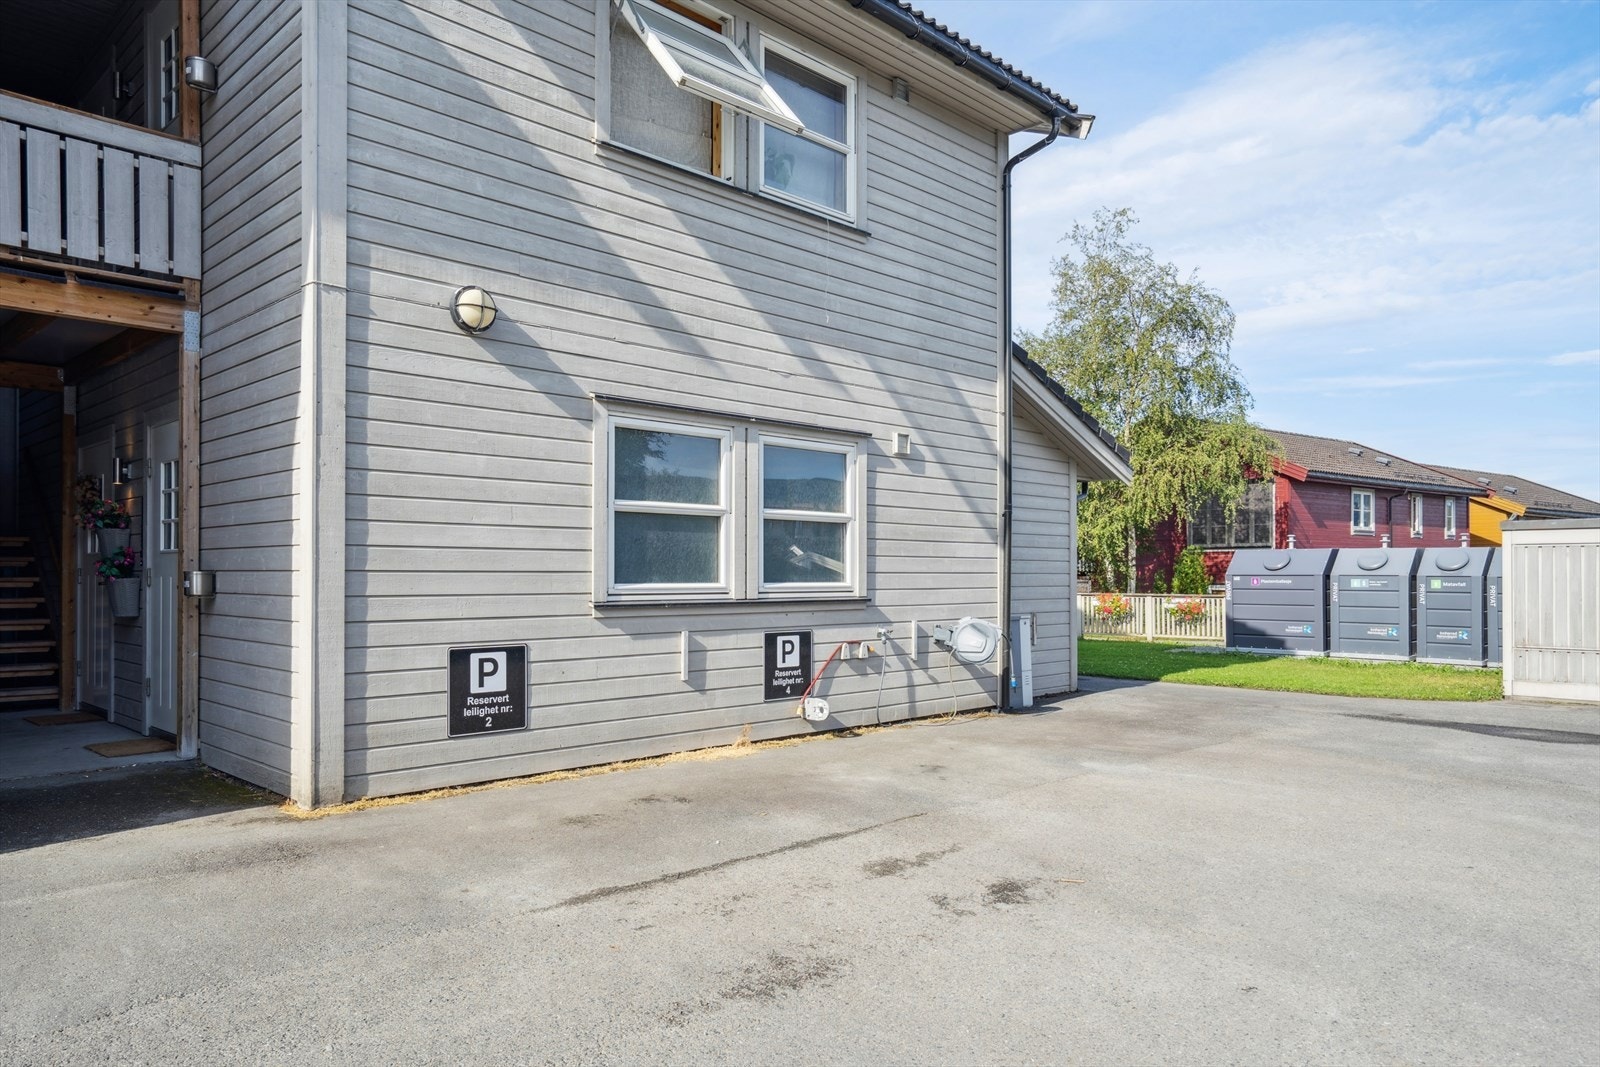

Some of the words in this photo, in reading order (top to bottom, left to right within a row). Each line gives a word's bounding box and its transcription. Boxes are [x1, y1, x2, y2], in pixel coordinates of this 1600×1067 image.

[782, 640, 795, 663] P
[478, 657, 499, 688] P
[775, 669, 801, 677] Reservert
[772, 678, 795, 686] leilighet
[785, 686, 791, 694] 4
[467, 694, 509, 706] Reservert
[463, 706, 499, 717] leilighet
[500, 705, 513, 713] nr:
[485, 716, 493, 727] 2
